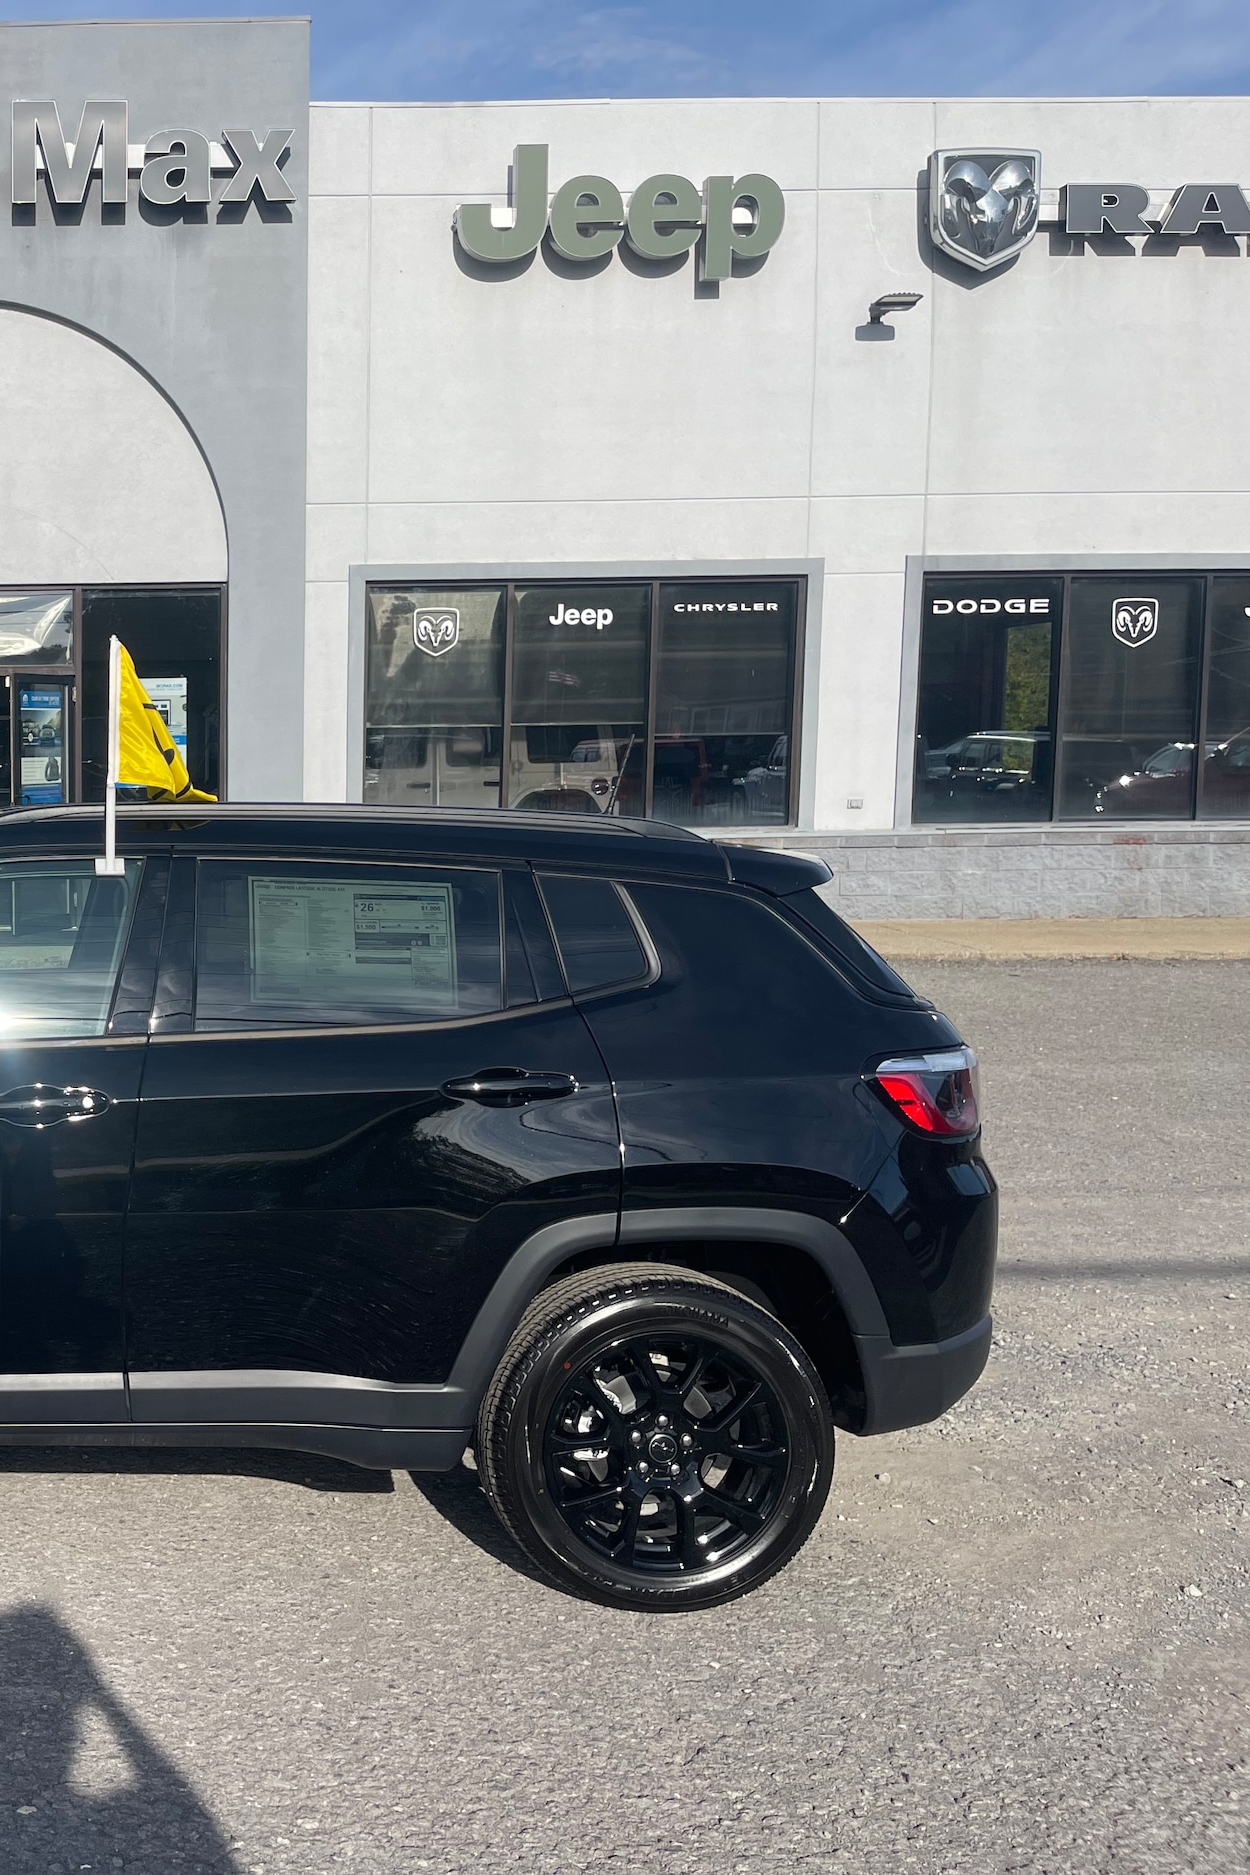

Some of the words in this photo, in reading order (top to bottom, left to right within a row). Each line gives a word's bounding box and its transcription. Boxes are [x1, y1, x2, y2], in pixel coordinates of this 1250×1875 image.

[12, 99, 296, 206] Max
[456, 143, 786, 283] Jeep
[548, 603, 614, 630] Jeep
[673, 602, 780, 613] CHRYSLER
[932, 598, 1050, 615] DODGE
[360, 902, 375, 913] 26
